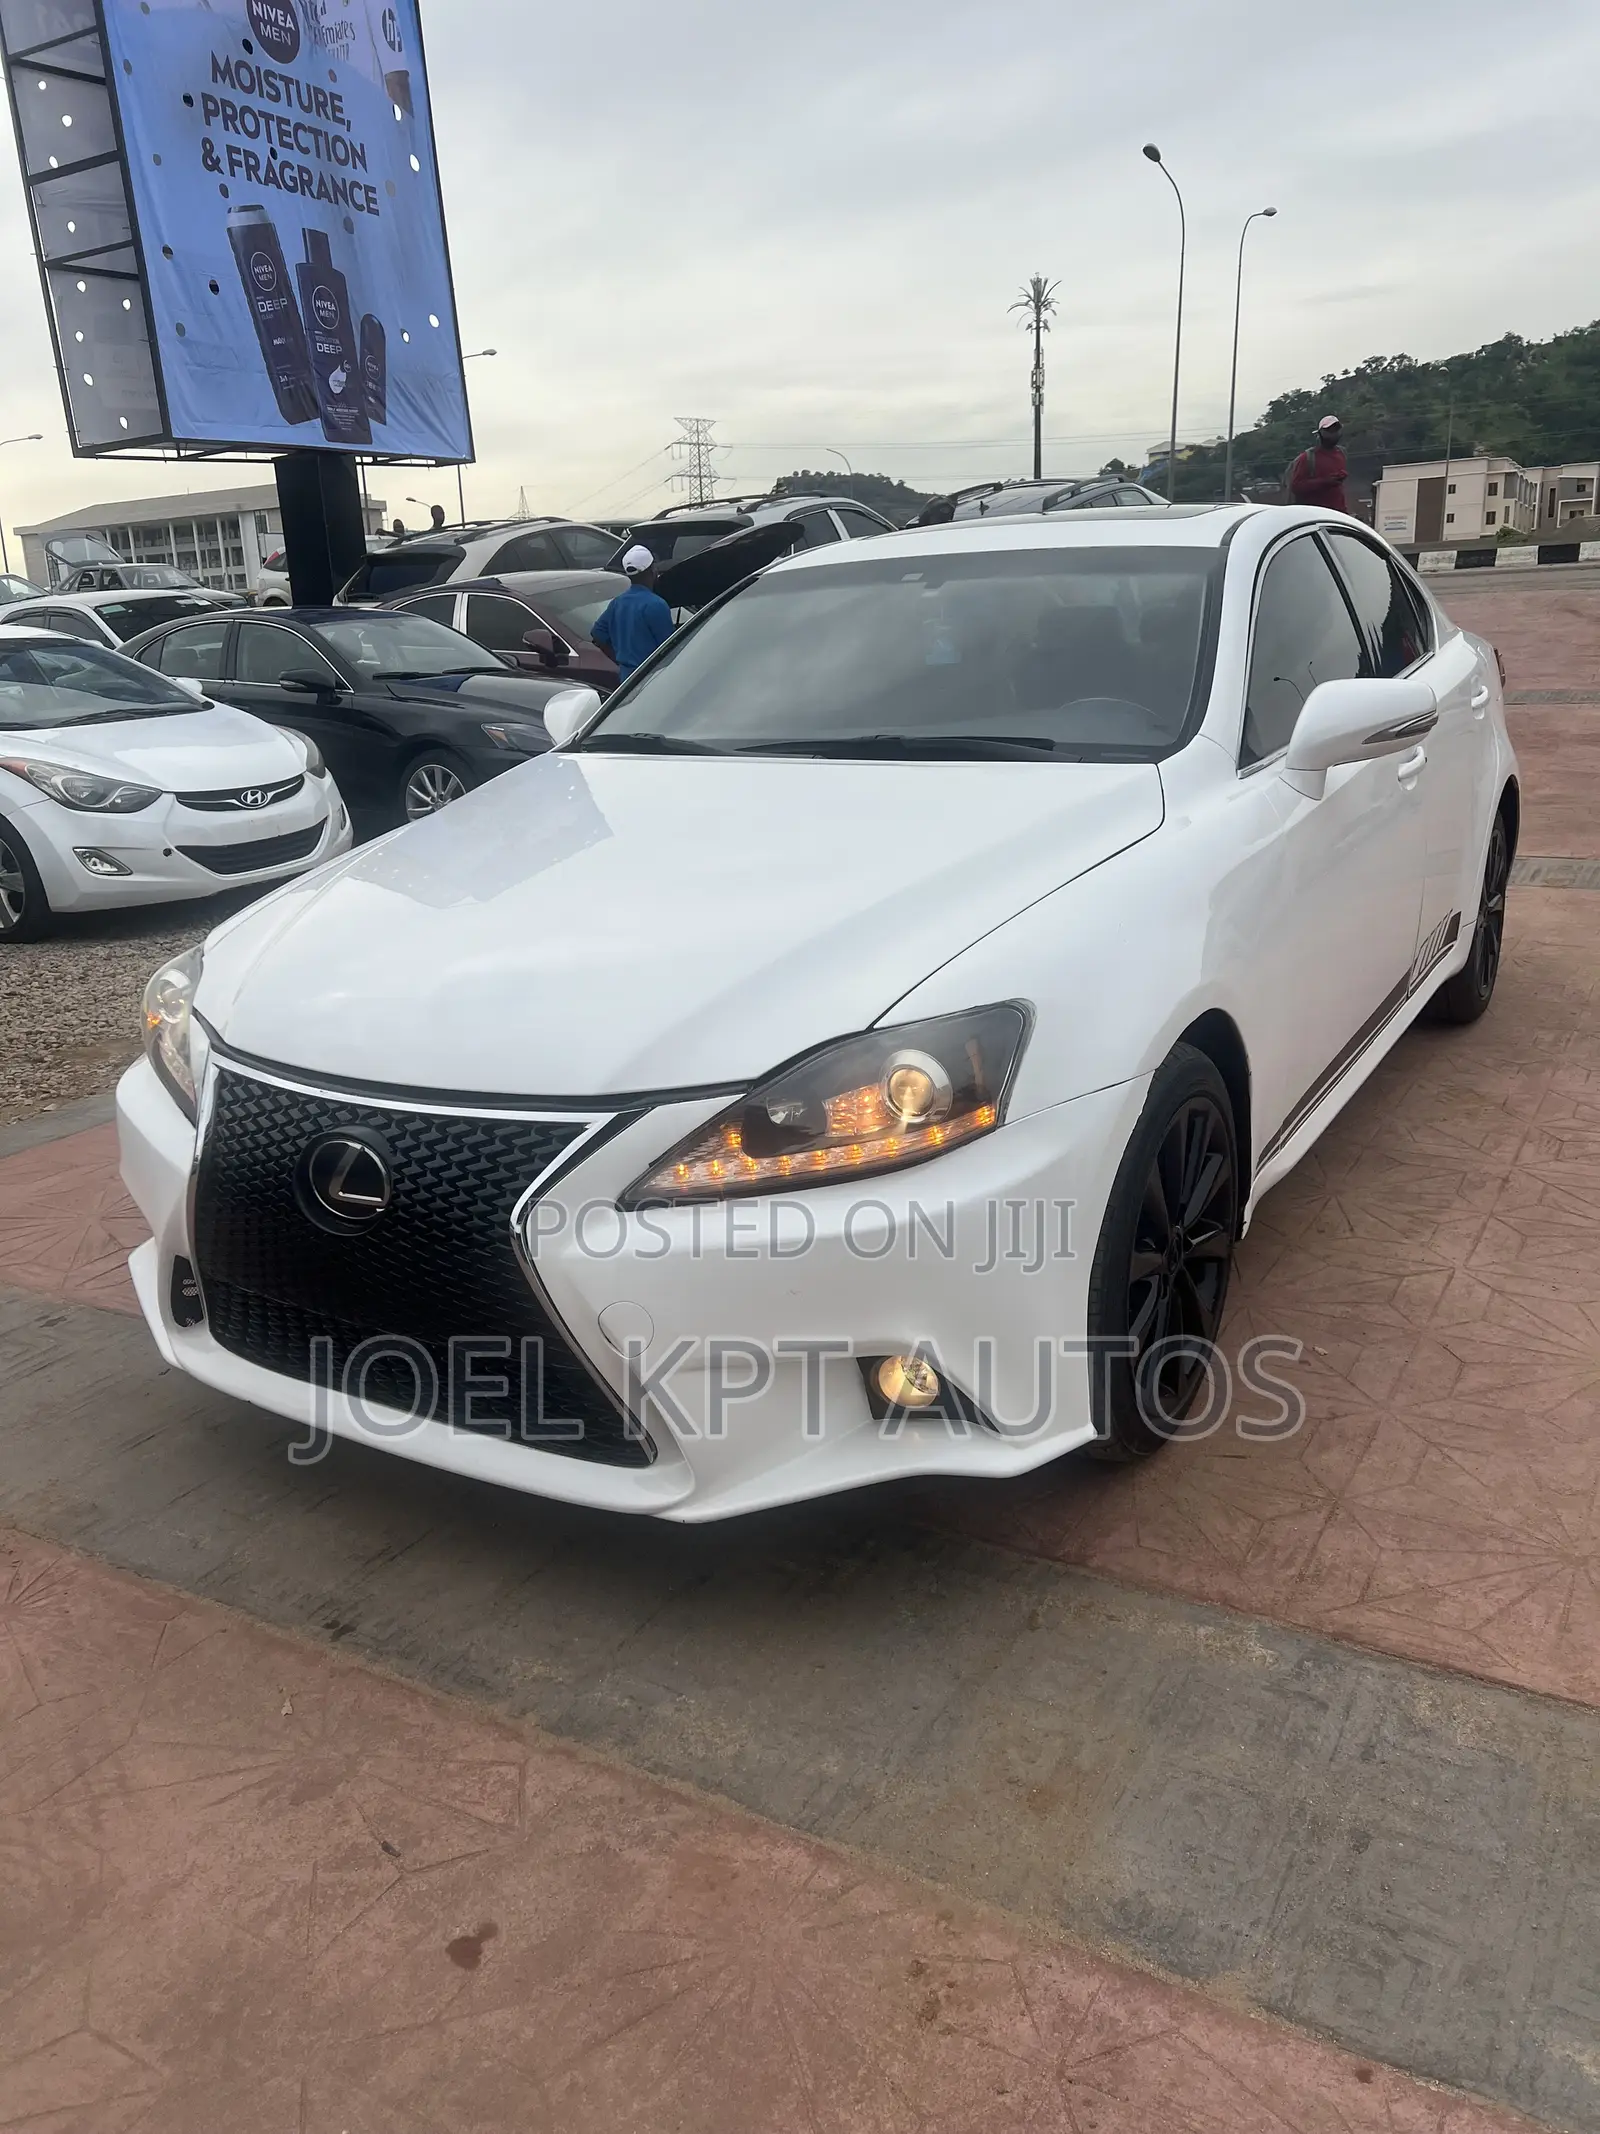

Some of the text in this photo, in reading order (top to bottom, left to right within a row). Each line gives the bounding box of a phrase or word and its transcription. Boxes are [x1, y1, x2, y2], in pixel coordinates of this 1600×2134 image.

[252, 1, 296, 31] NIVEA
[259, 21, 292, 46] MEN
[211, 50, 351, 132] MOISTURE,
[200, 92, 368, 173] PROTECTION
[201, 137, 380, 216] & FRAGRANCE
[253, 264, 273, 274] NIVEA
[258, 273, 273, 281] MEN
[257, 297, 288, 313] DEEP
[315, 299, 336, 311] NIVEA
[319, 309, 335, 318] MEN
[316, 342, 342, 354] DEEP
